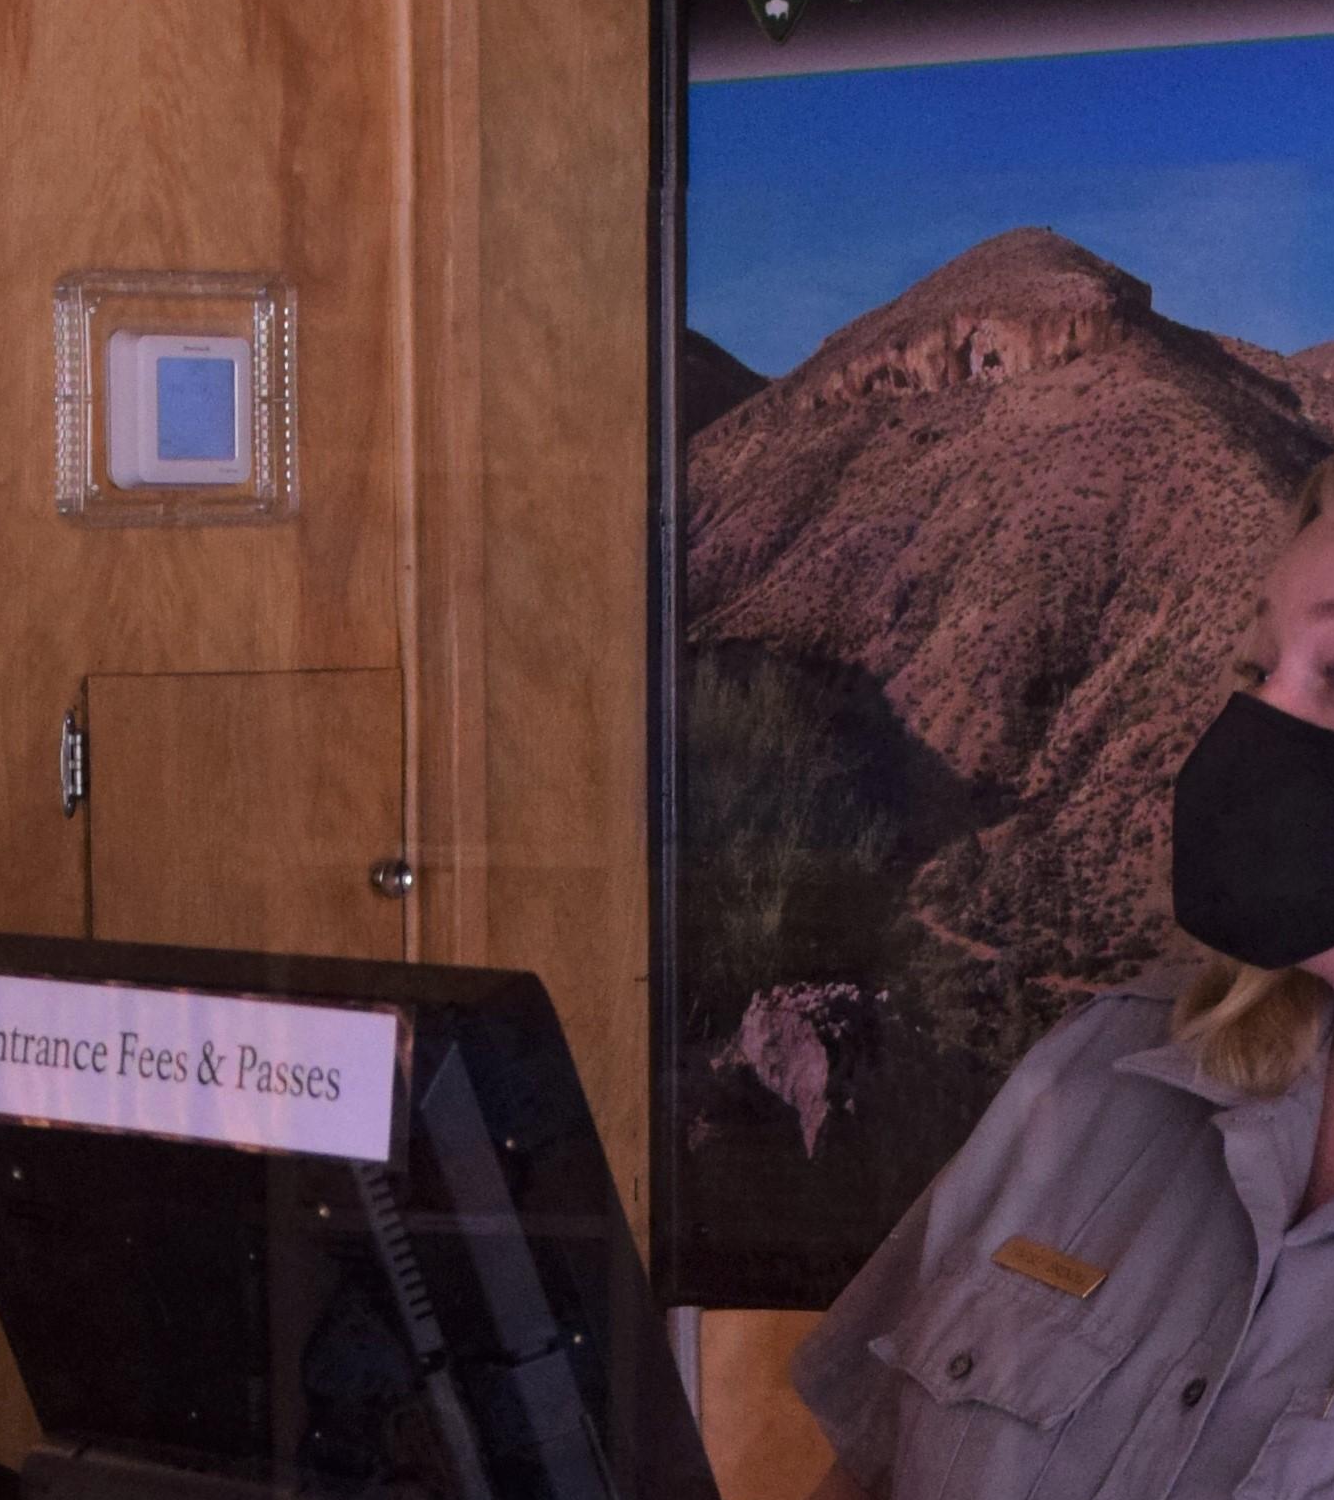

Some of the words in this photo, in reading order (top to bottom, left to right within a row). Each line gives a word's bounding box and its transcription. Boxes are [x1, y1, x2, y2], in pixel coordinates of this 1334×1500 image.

[116, 1030, 188, 1083] Fees
[196, 1039, 227, 1087] &
[235, 1044, 342, 1101] Passes
